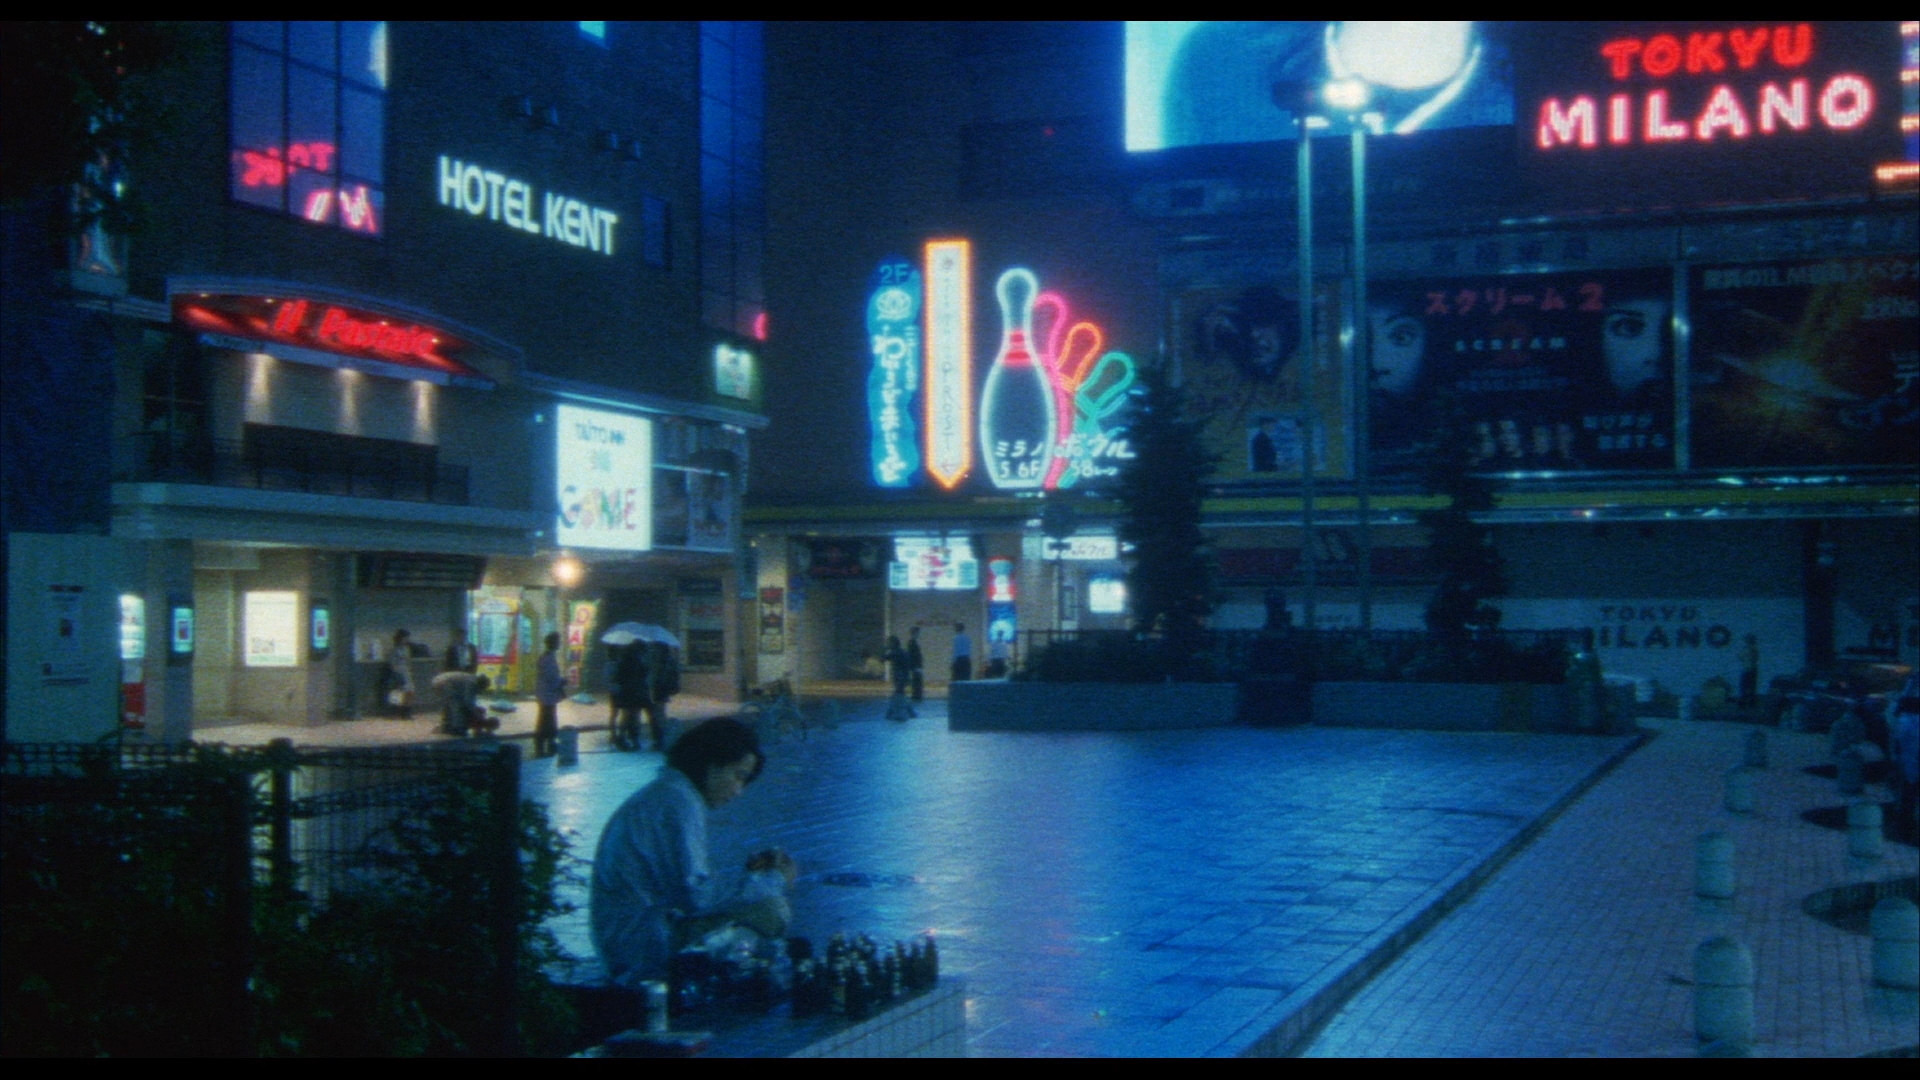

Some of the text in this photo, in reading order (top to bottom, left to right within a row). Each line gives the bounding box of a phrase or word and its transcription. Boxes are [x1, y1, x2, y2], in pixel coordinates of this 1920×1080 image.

[1601, 24, 1814, 78] TOKYU
[1537, 74, 1875, 149] MILANO
[438, 155, 618, 255] HOTEL KENT
[879, 264, 909, 284] 2F
[1424, 281, 1605, 316] スクリーム 2
[1453, 336, 1568, 353] SCREAM
[1018, 459, 1042, 478] 6F
[559, 484, 638, 531] GAME
[1599, 604, 1699, 621] TOKYU
